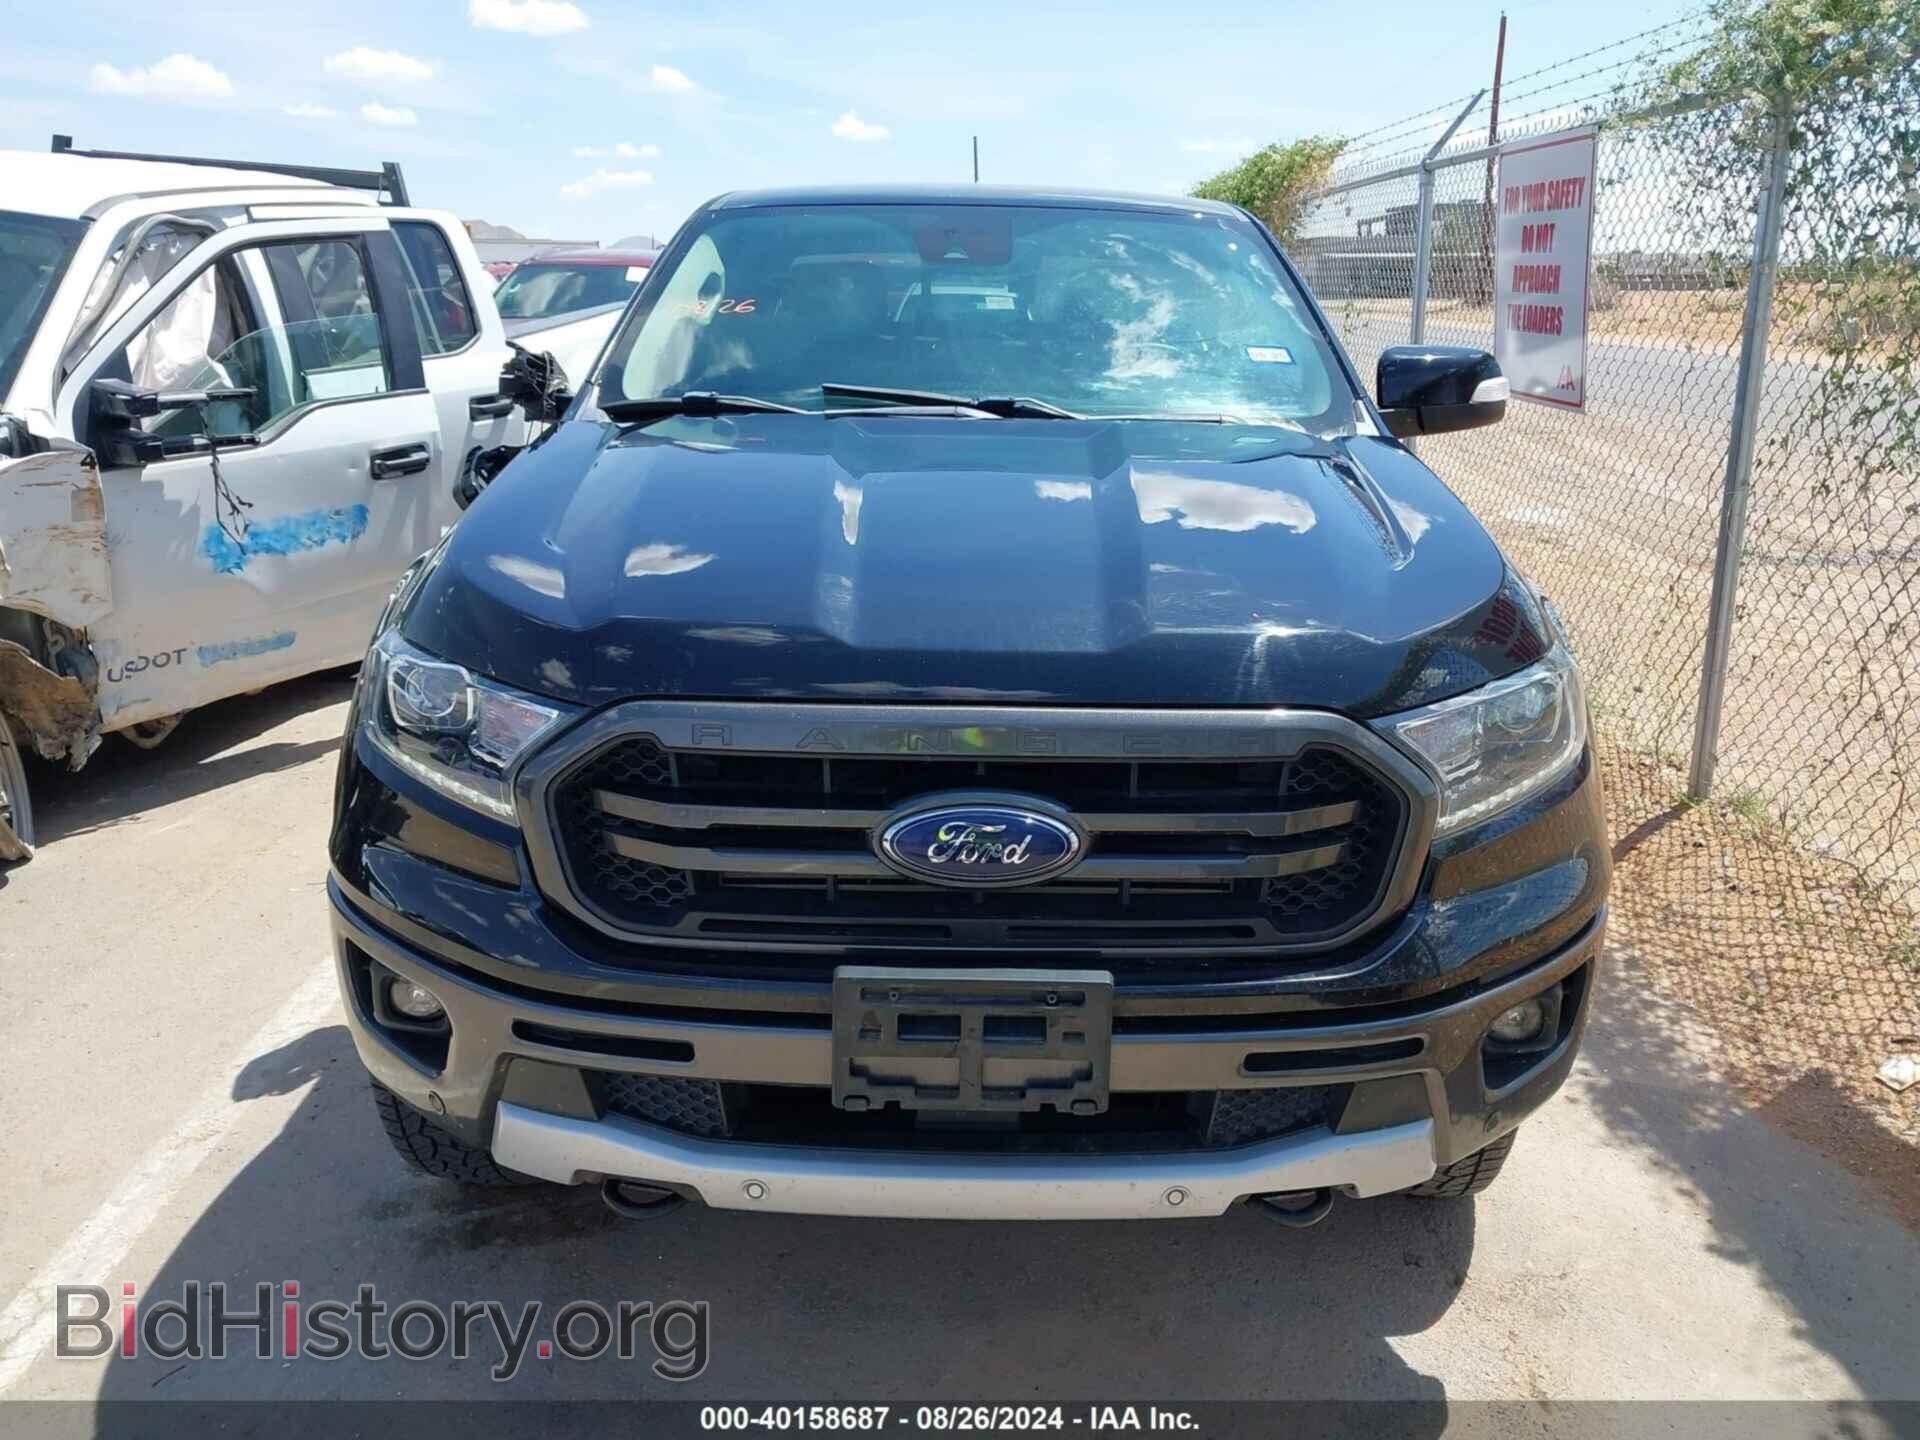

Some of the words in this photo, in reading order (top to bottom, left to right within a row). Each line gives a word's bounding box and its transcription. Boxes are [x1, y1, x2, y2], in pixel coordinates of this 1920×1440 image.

[1504, 185, 1521, 216] FOR
[1521, 181, 1546, 213] YOUR
[1547, 176, 1586, 211] SAFETY
[1521, 224, 1535, 254] DO
[1535, 222, 1556, 254] NOT
[1511, 264, 1562, 294] APPROACH
[1506, 303, 1522, 332] THE
[1522, 304, 1565, 337] LOADERS
[690, 722, 1275, 754] RANGER
[927, 821, 1033, 864] Ford
